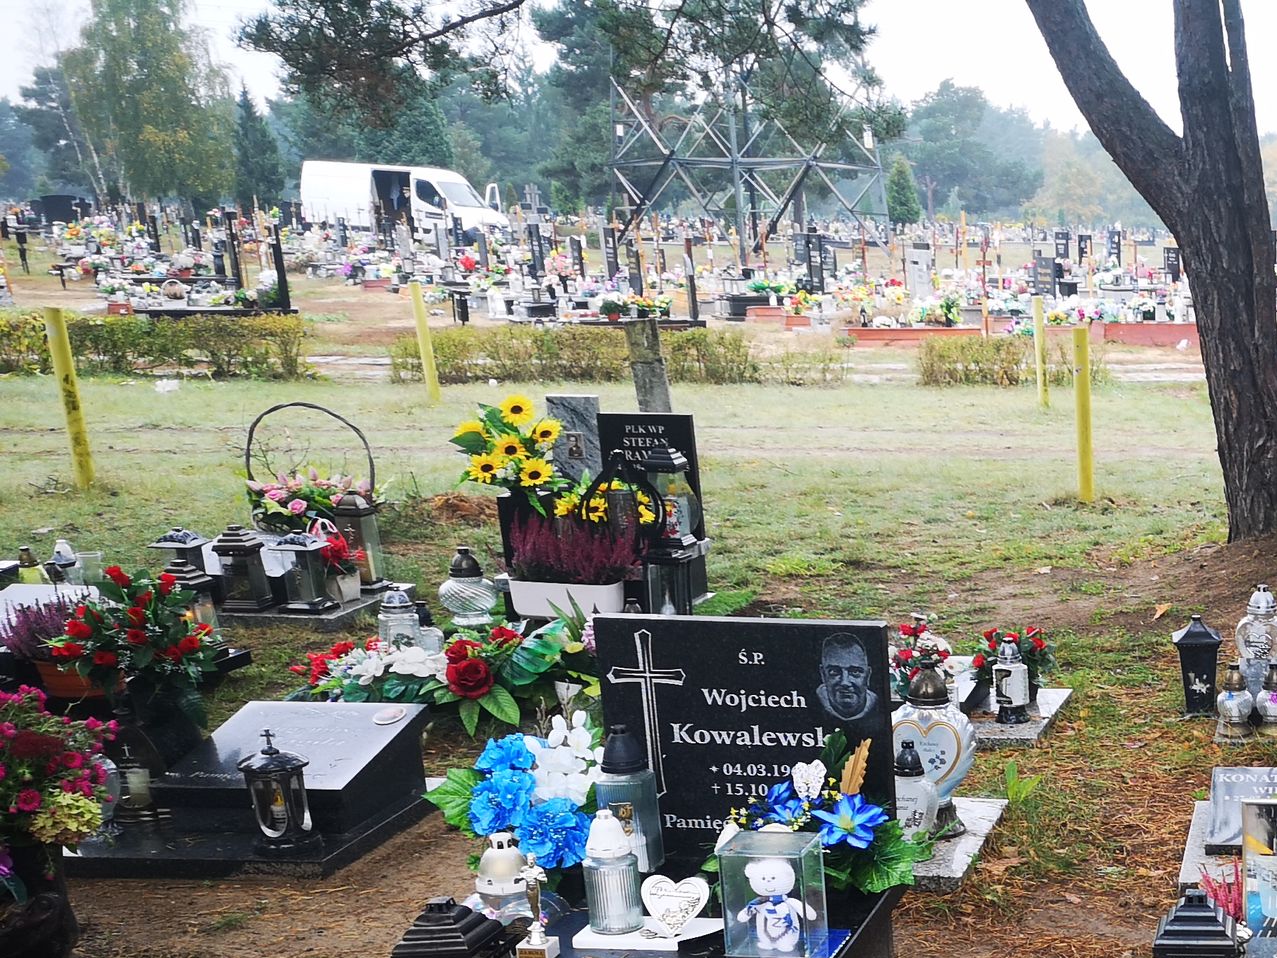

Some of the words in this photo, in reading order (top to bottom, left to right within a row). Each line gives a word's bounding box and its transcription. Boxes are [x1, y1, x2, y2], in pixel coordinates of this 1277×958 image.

[625, 425, 646, 434] PLK
[648, 425, 665, 434] WP
[738, 649, 765, 665] Ś.P.
[701, 688, 807, 712] Wojciech
[670, 722, 840, 749] Kowalewsk
[722, 763, 793, 777] 04.03.19
